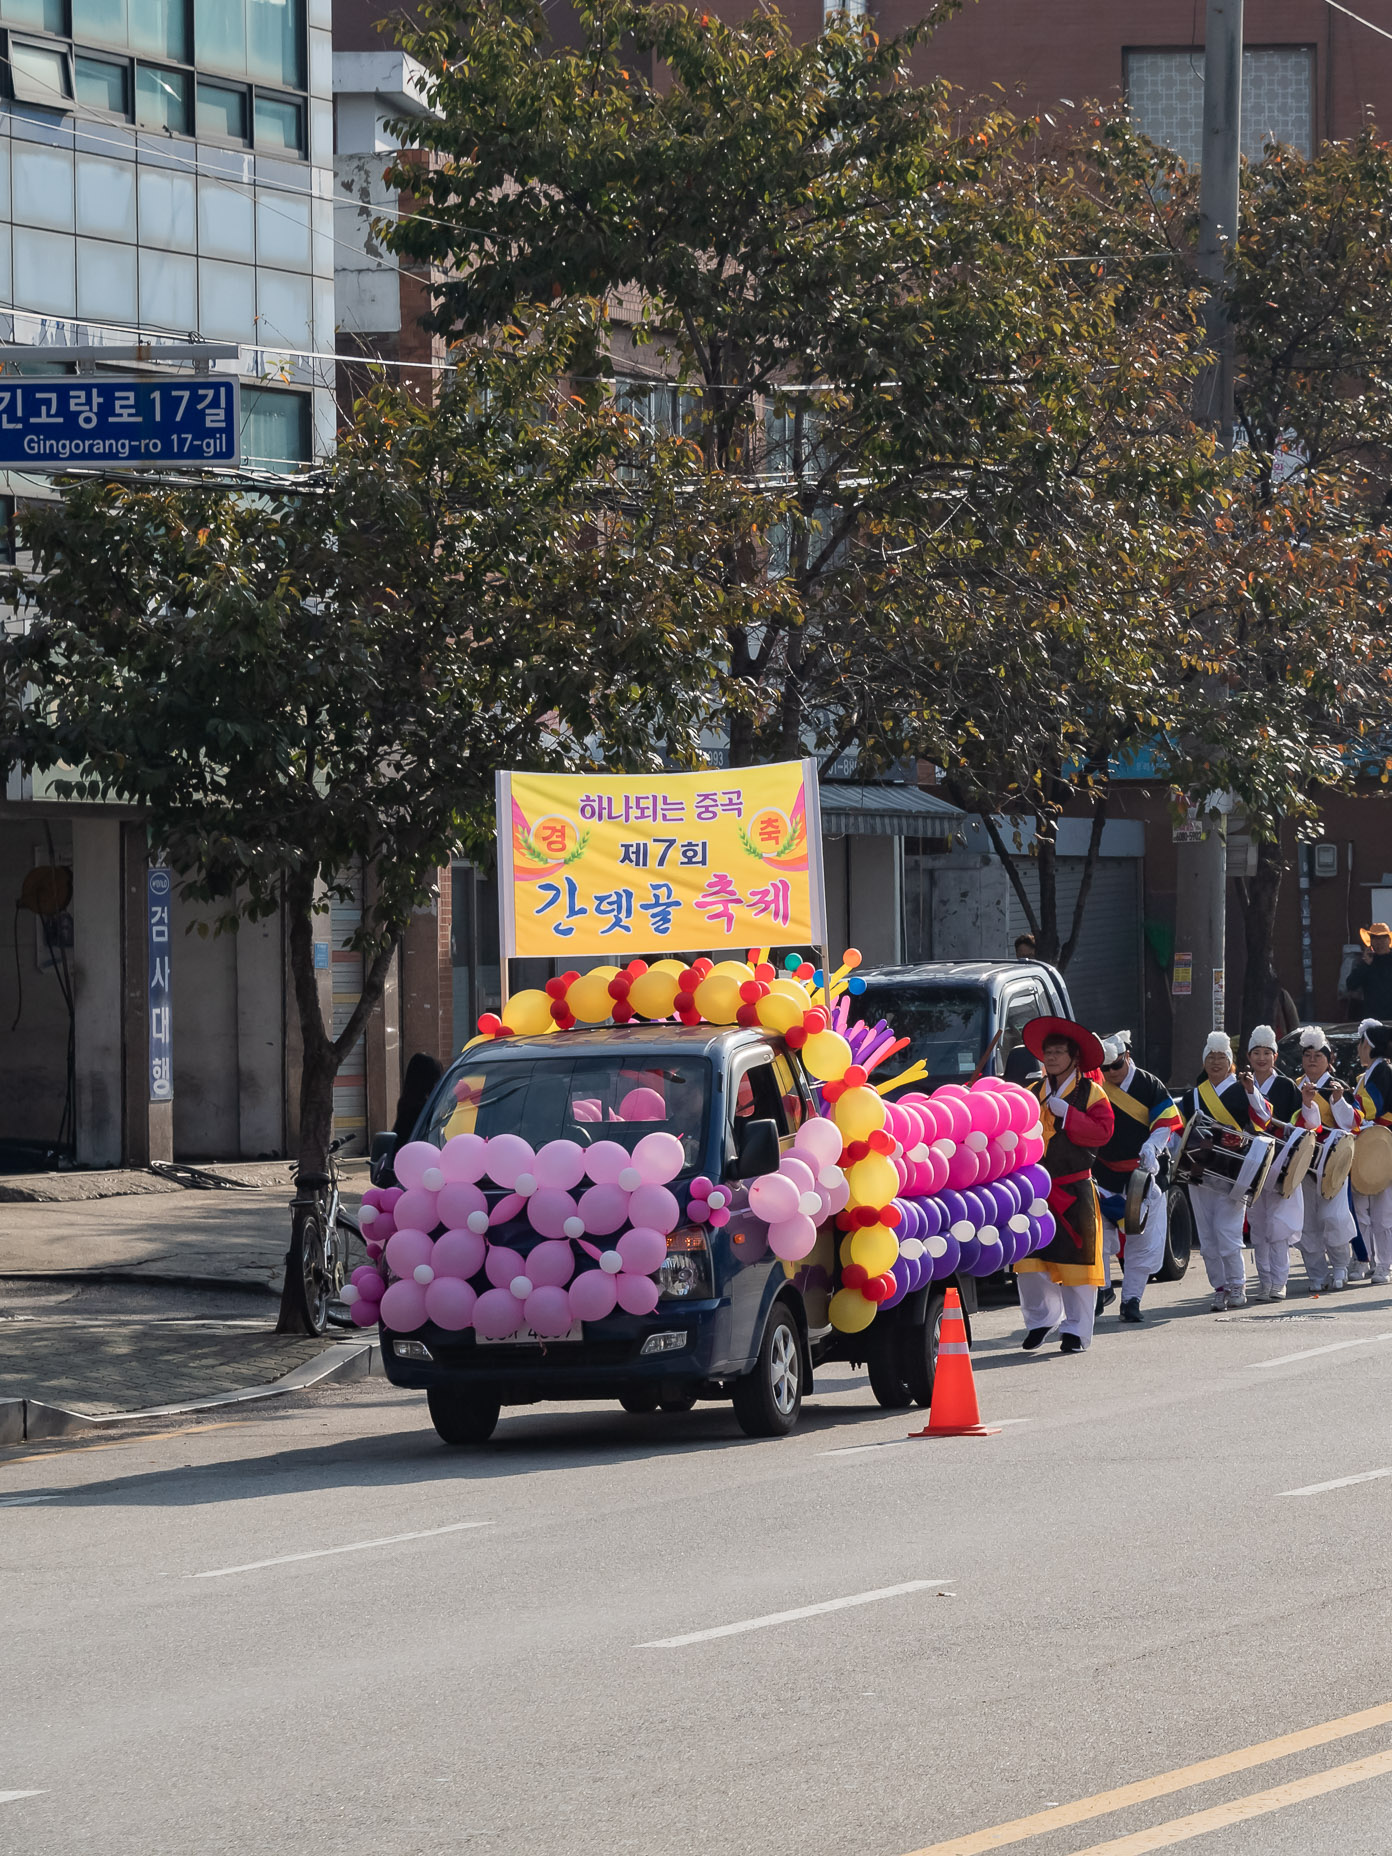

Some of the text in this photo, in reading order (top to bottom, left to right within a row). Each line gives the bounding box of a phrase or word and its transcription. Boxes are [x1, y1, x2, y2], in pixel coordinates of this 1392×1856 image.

[0, 388, 226, 429] 긴고랑로17길
[24, 434, 226, 458] Gingorang-ro 17-gil
[579, 789, 744, 825] 하나되는 중곡
[541, 824, 568, 853] 경
[758, 817, 784, 846] 축
[619, 837, 708, 868] 제7회
[535, 873, 791, 936] 간뎃골 축제
[151, 906, 170, 1094] 검사대행
